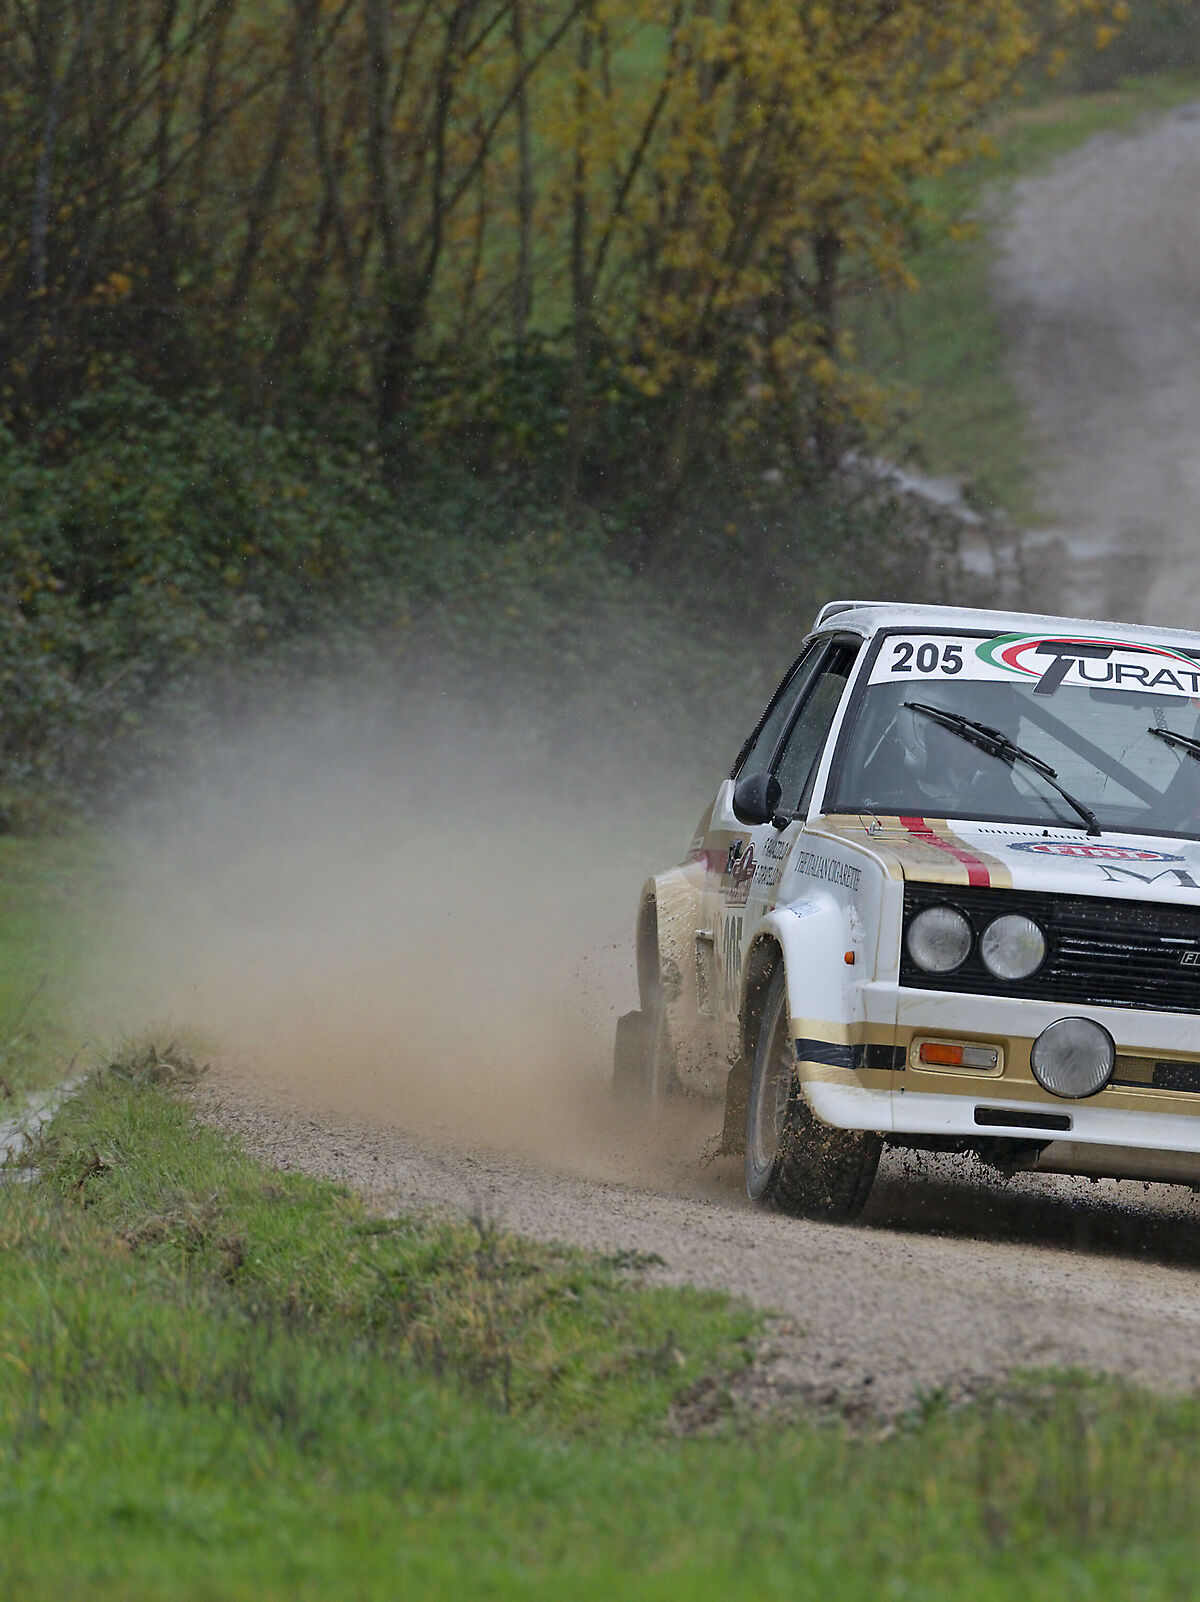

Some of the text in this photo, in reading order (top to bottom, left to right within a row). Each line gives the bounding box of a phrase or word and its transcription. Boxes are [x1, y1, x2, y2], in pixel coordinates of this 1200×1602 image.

[891, 642, 963, 675] 205
[795, 851, 810, 873] THE
[804, 853, 831, 880] ITALIAN
[828, 860, 862, 891] CIGARETTE
